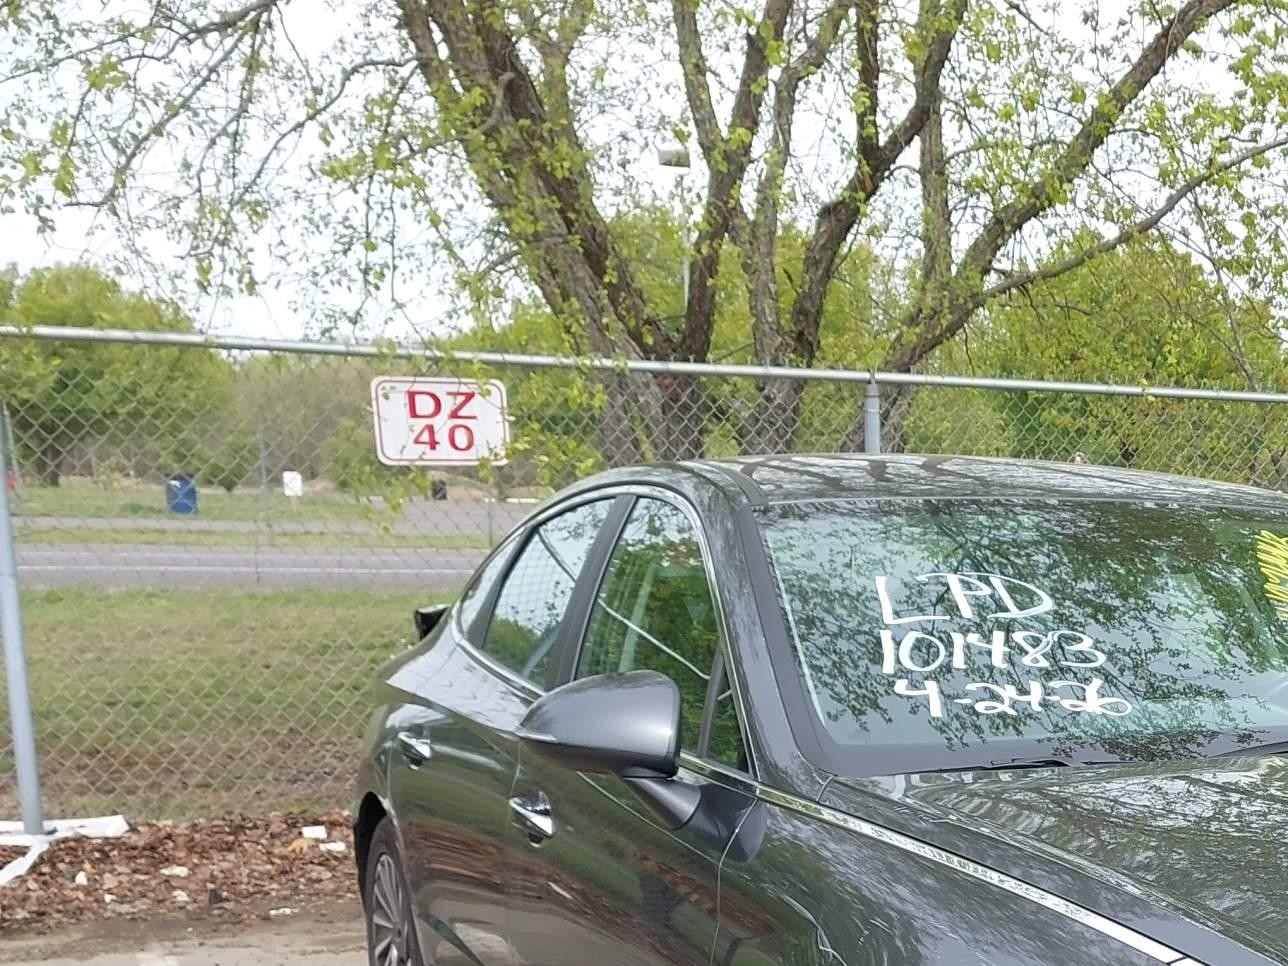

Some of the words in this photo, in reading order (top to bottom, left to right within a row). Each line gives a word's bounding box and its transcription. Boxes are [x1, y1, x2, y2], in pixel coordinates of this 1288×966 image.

[406, 390, 478, 420] DZ
[412, 423, 475, 452] 40
[875, 571, 1054, 625] LPD
[879, 629, 1107, 674] 101483
